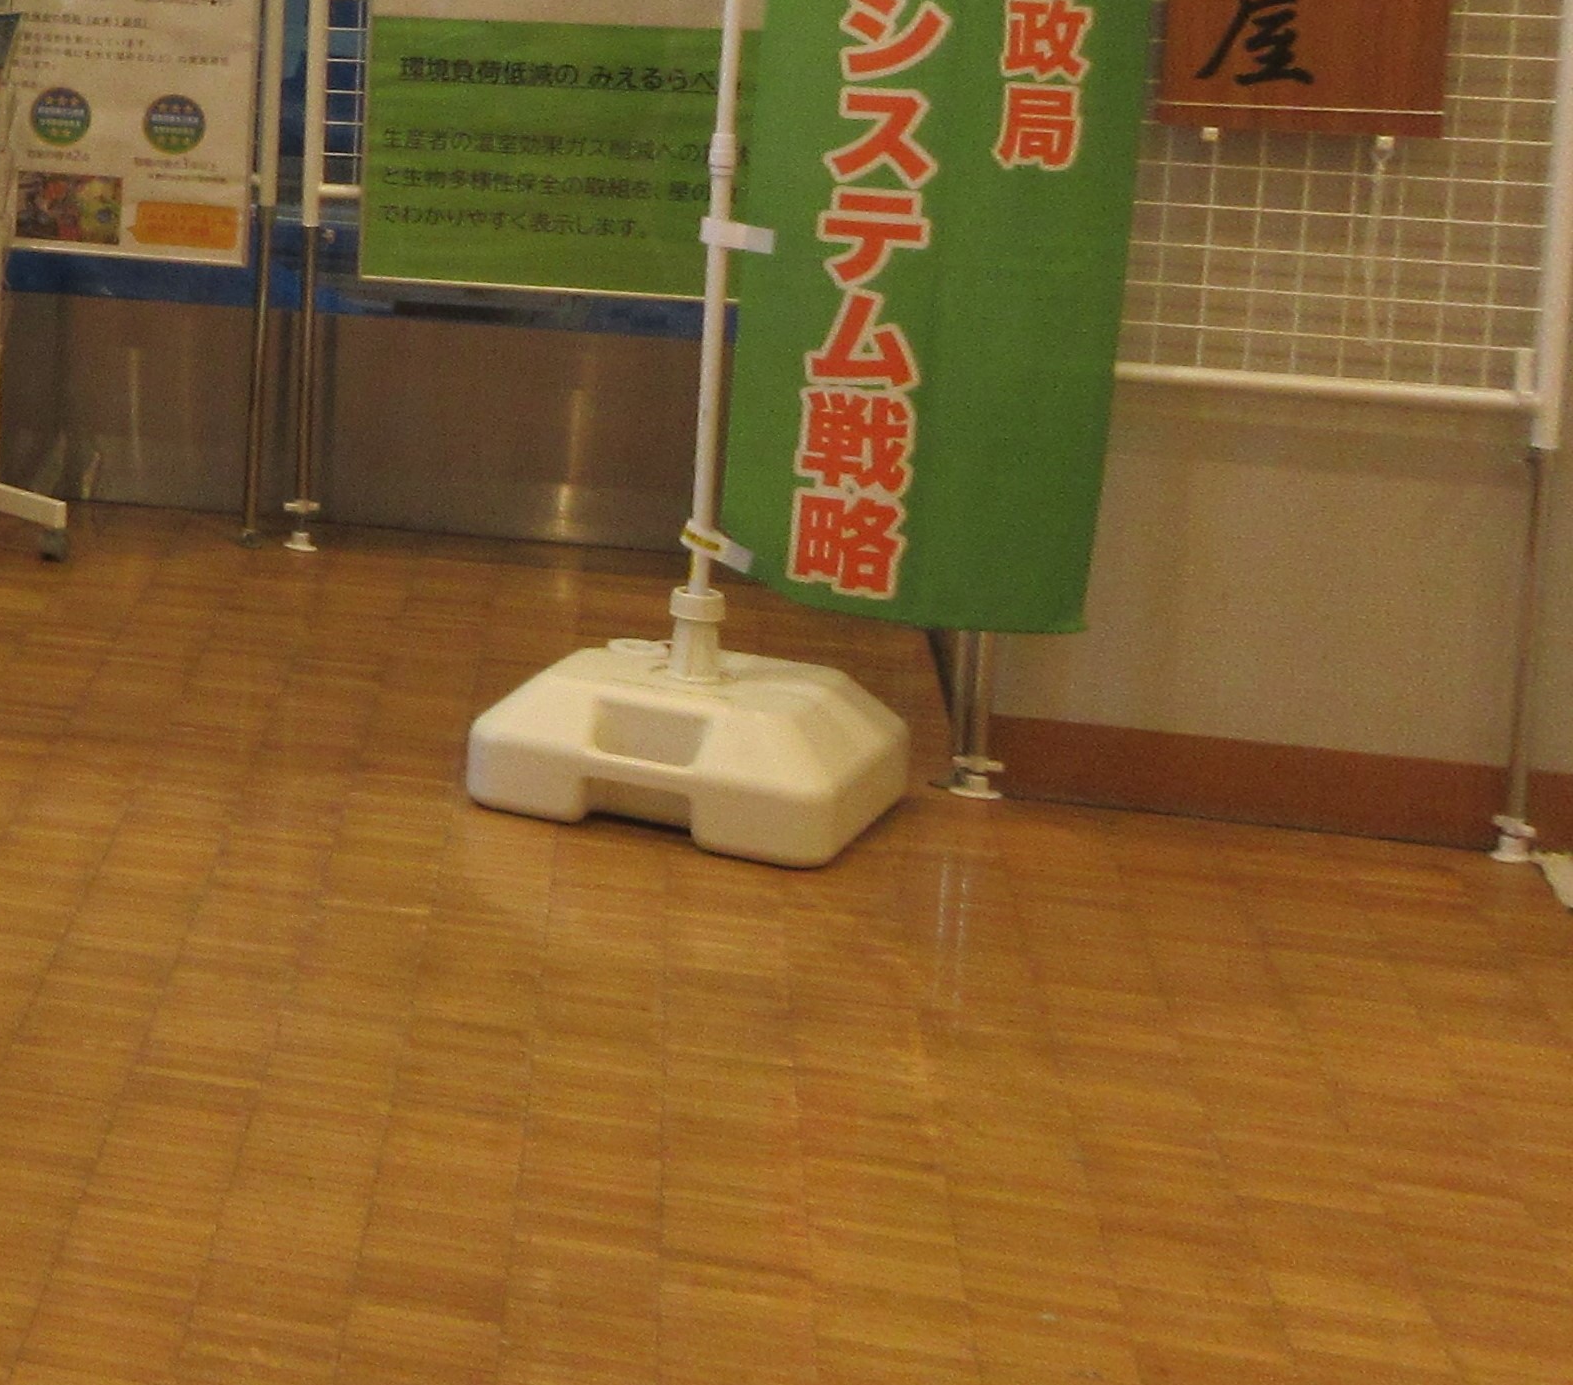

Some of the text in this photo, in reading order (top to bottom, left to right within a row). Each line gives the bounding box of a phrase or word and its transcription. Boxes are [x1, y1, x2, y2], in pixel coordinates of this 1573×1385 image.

[588, 64, 741, 93] みえるらべ
